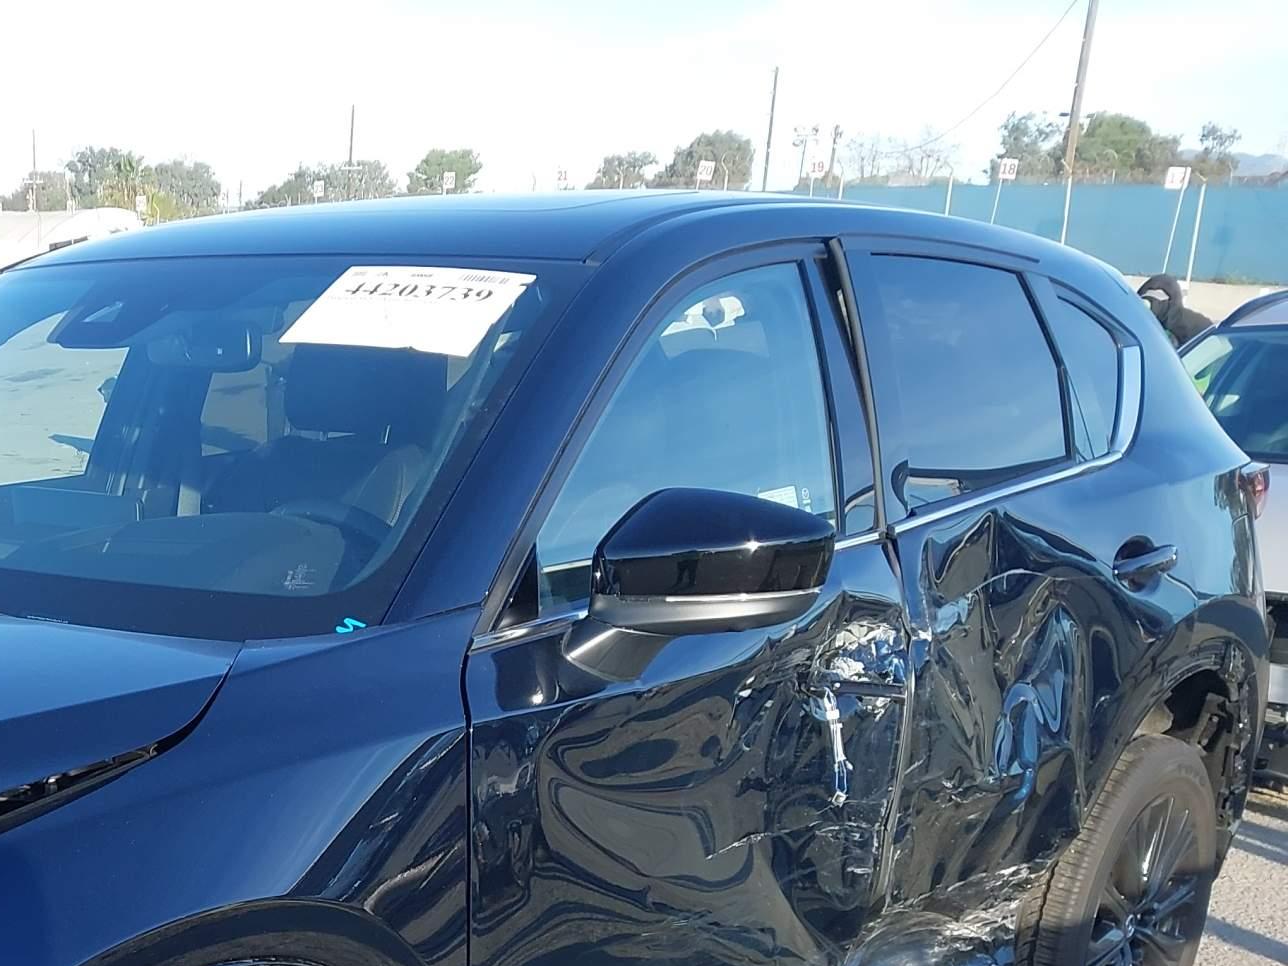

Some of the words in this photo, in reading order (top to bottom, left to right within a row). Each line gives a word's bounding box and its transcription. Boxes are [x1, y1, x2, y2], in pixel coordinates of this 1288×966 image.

[699, 165, 713, 176] 20
[811, 161, 824, 173] 19
[1001, 163, 1016, 175] 18
[557, 170, 568, 181] 21
[345, 281, 493, 301] 44203739
